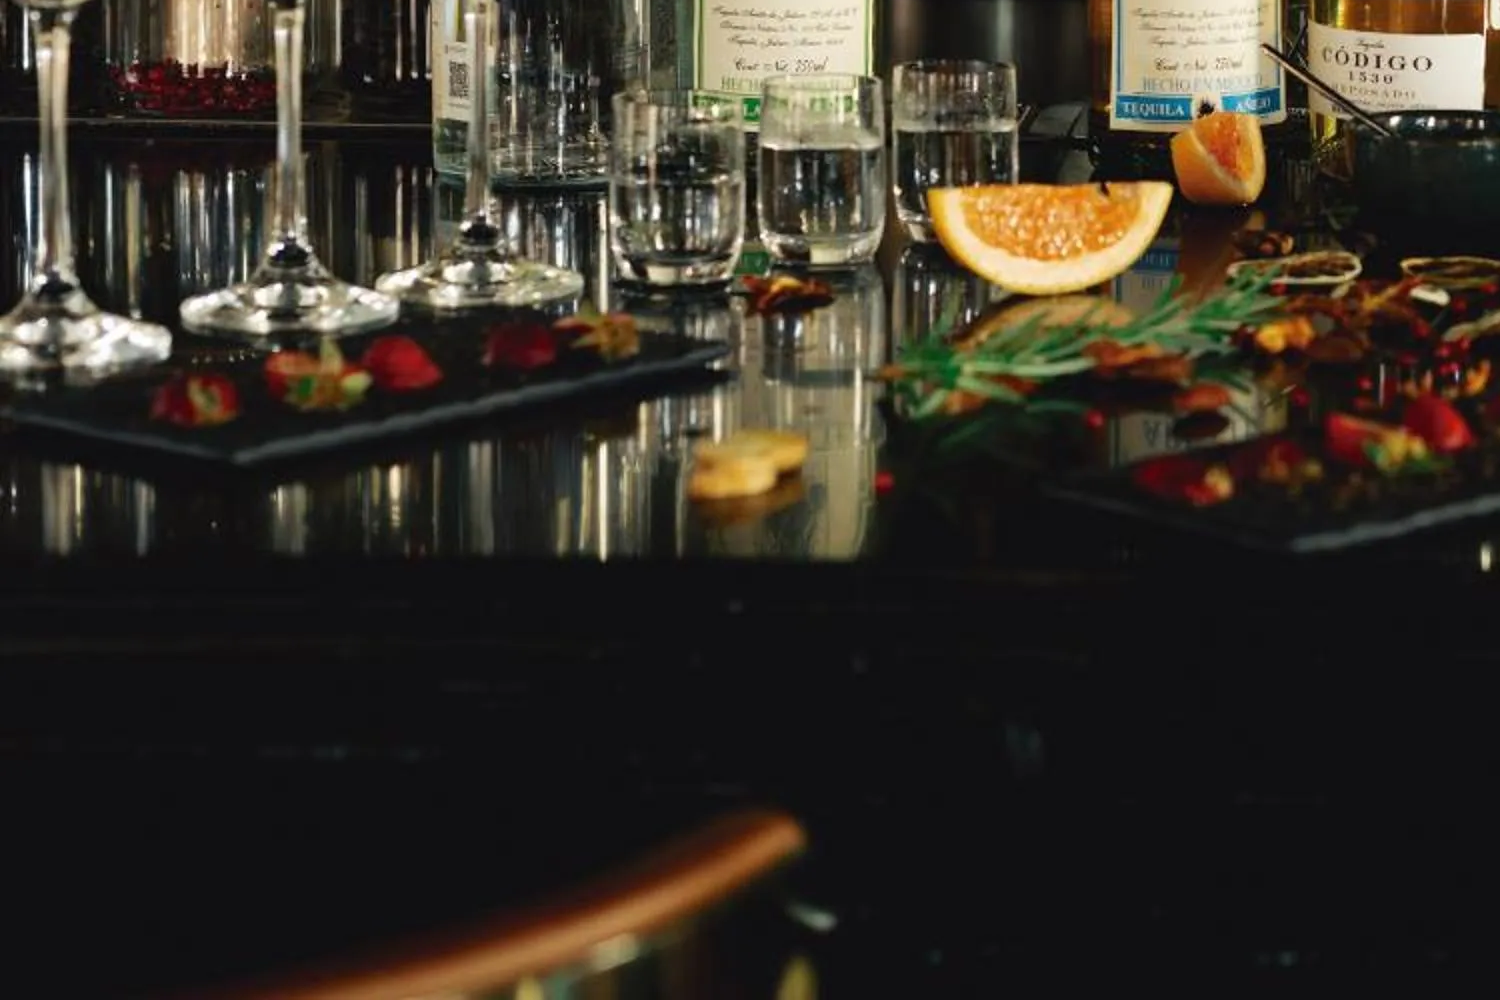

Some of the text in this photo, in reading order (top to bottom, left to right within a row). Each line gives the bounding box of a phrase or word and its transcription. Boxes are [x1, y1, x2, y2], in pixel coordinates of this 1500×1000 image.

[1321, 44, 1433, 72] CÓDIGO
[1347, 70, 1395, 85] 1530
[1122, 101, 1186, 118] TEQUILA
